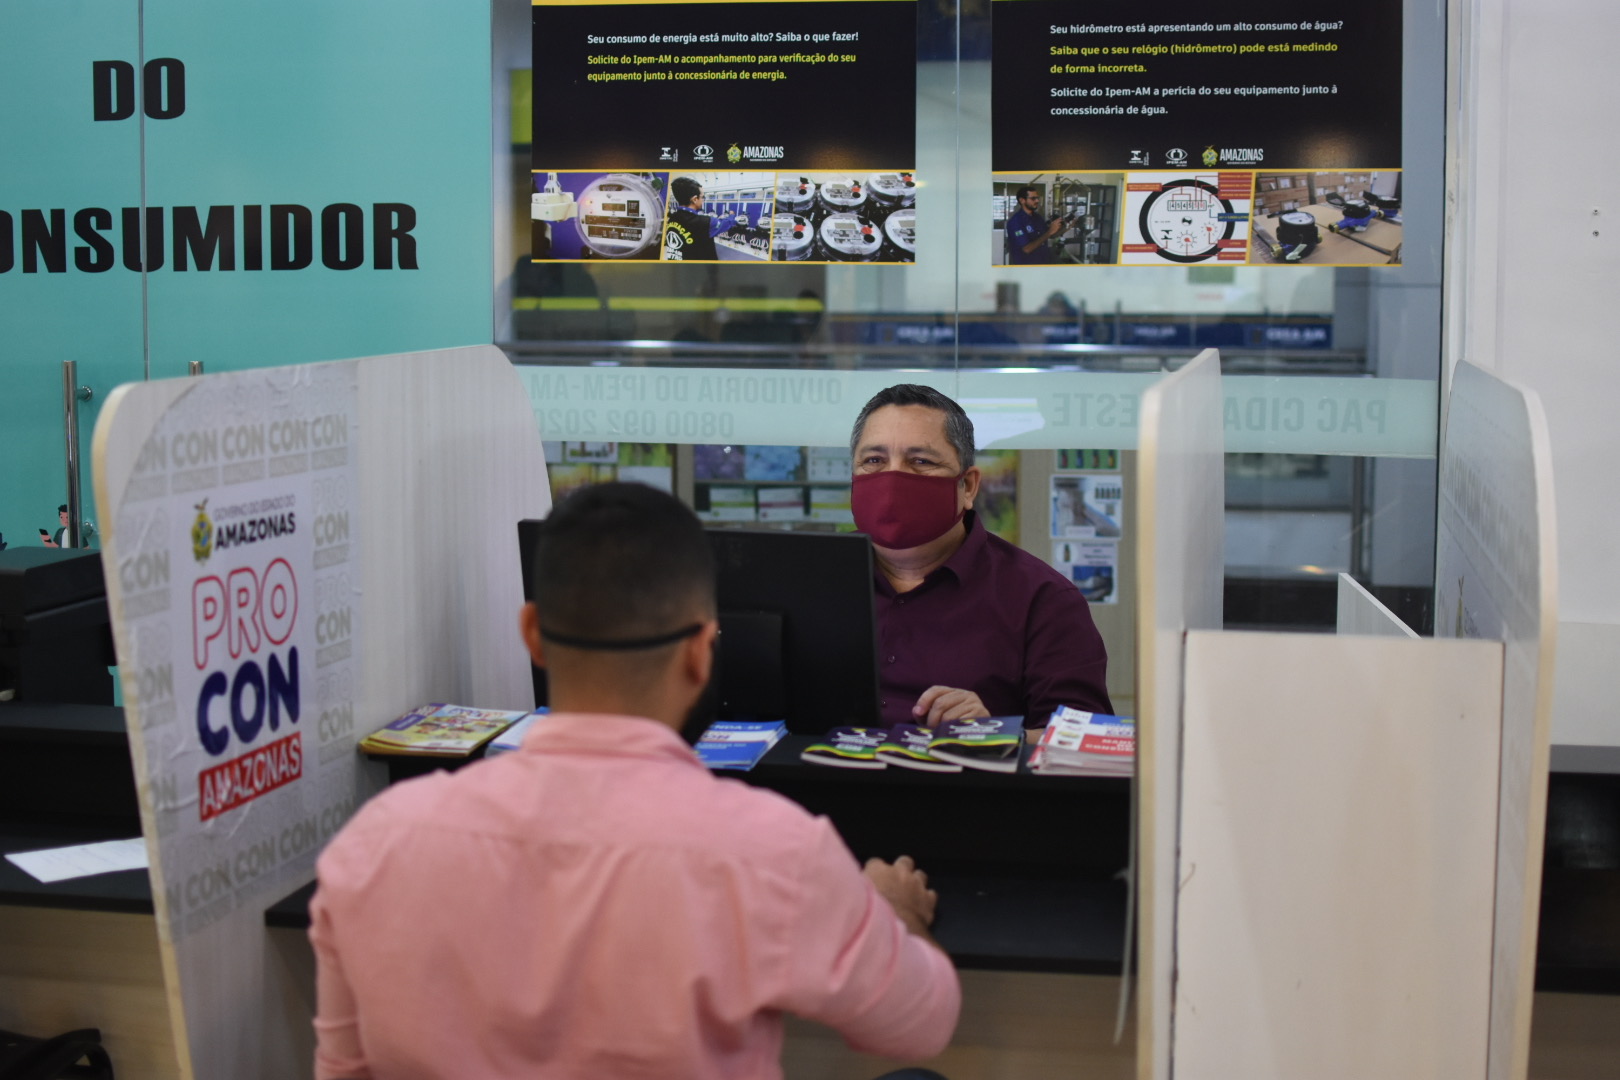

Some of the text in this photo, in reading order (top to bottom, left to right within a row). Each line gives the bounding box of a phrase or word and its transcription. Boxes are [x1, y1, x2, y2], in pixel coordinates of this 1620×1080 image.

[1049, 20, 1344, 35] Seu hidrômetro está apresentando um alto consumo de água?
[587, 31, 859, 45] Seu consumo de energia está muito alto? Saiba o que fazer!
[1050, 42, 1338, 57] Saiba que o seu relógio (hidrômetro) pode está medindo
[587, 52, 857, 66] Solicite do Ipem-AM o acompanhamento para verificação do seu
[587, 69, 787, 83] equipamento junto à concessionária de energia.
[1049, 63, 1147, 74] de forma incorreta.
[93, 57, 186, 121] DO
[1050, 84, 1338, 98] Solicite do Ipem-AM a perícia do seu equipamento junto à
[1050, 104, 1169, 117] concessionária de água.
[743, 146, 784, 159] AMAZONAS
[1220, 148, 1264, 161] AMAZONAS
[171, 429, 218, 468] CON
[222, 423, 265, 459] CON
[268, 418, 308, 453] CON
[311, 413, 348, 447] CON
[214, 511, 296, 551] AMAZONAS
[313, 510, 349, 547] CON
[192, 557, 298, 670] PRO
[315, 606, 352, 646] CON
[196, 646, 300, 756] CON
[317, 701, 354, 742] CON
[201, 737, 301, 816] AMAZONAS
